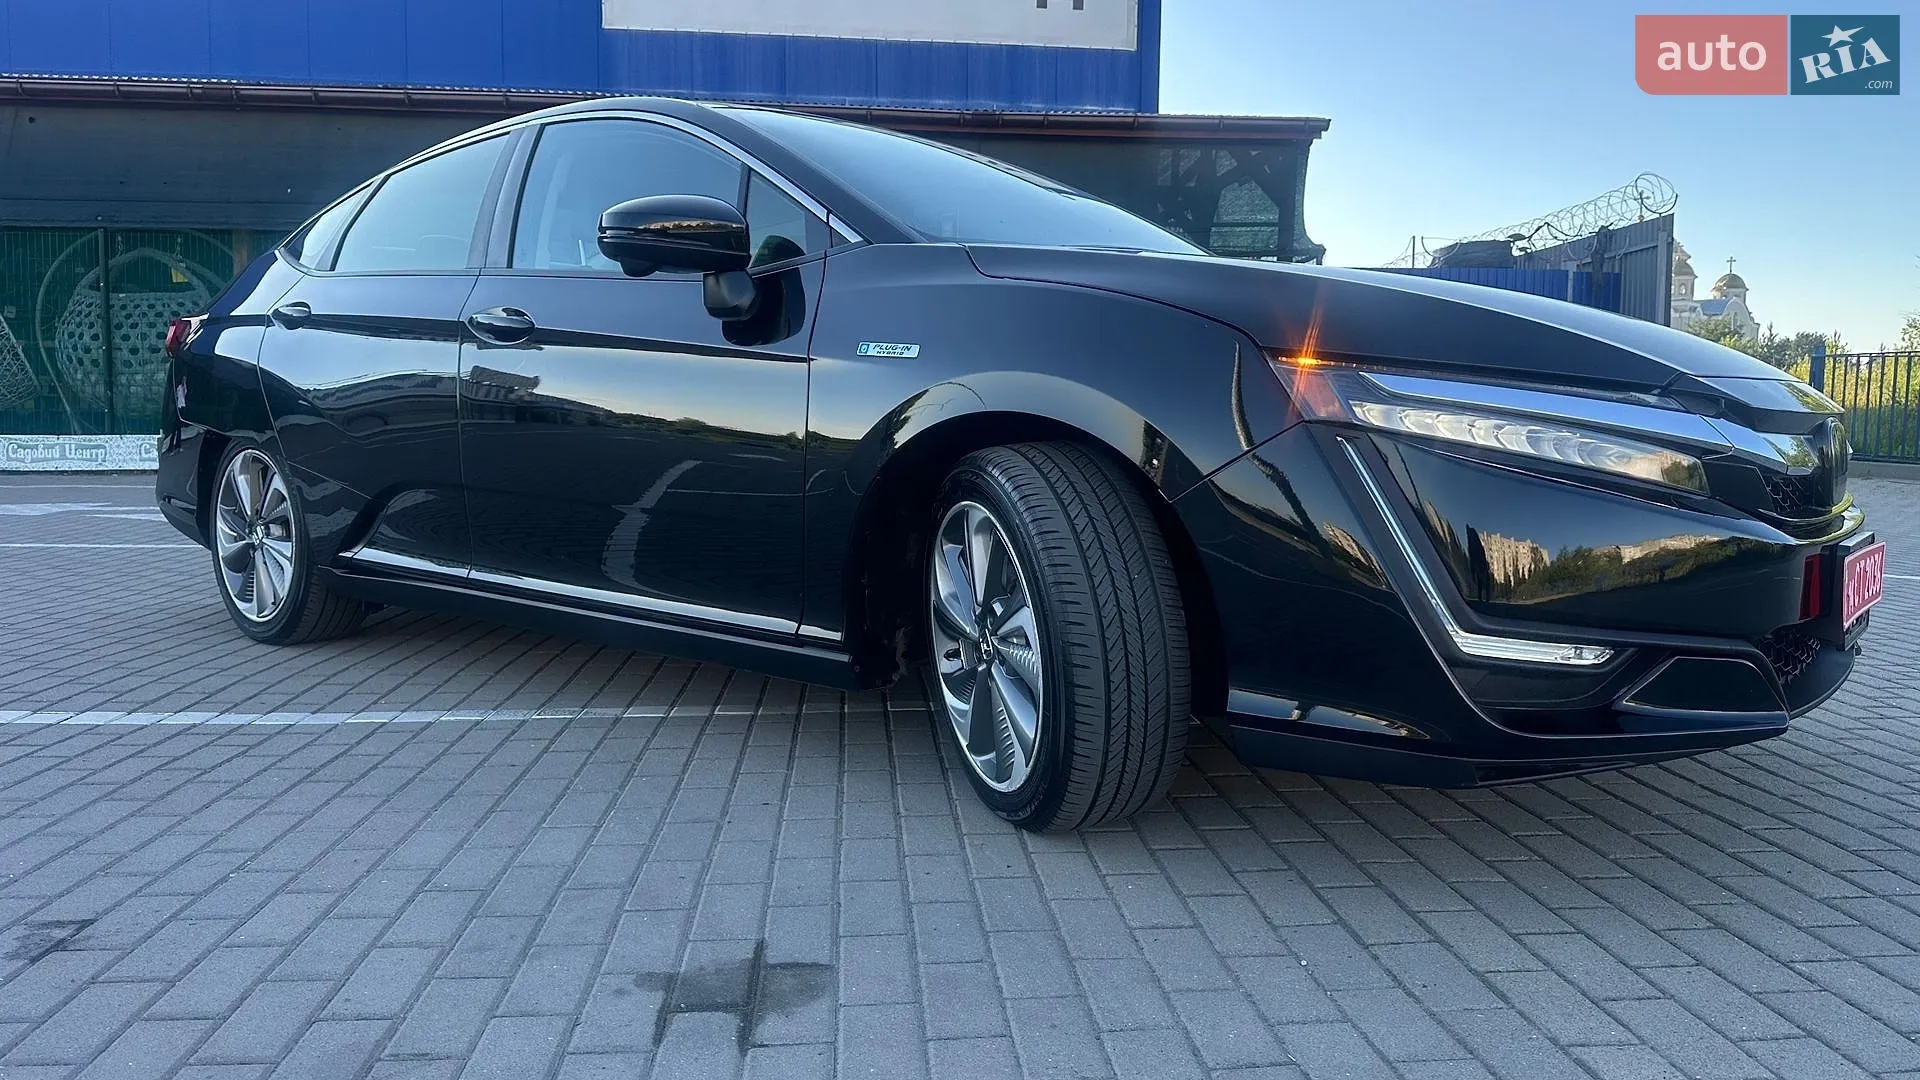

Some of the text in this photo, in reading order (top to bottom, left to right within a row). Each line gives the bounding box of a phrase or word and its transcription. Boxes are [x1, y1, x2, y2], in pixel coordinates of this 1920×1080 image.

[872, 344, 913, 352] PLUG-IN
[8, 443, 105, 462] Садовий Центр
